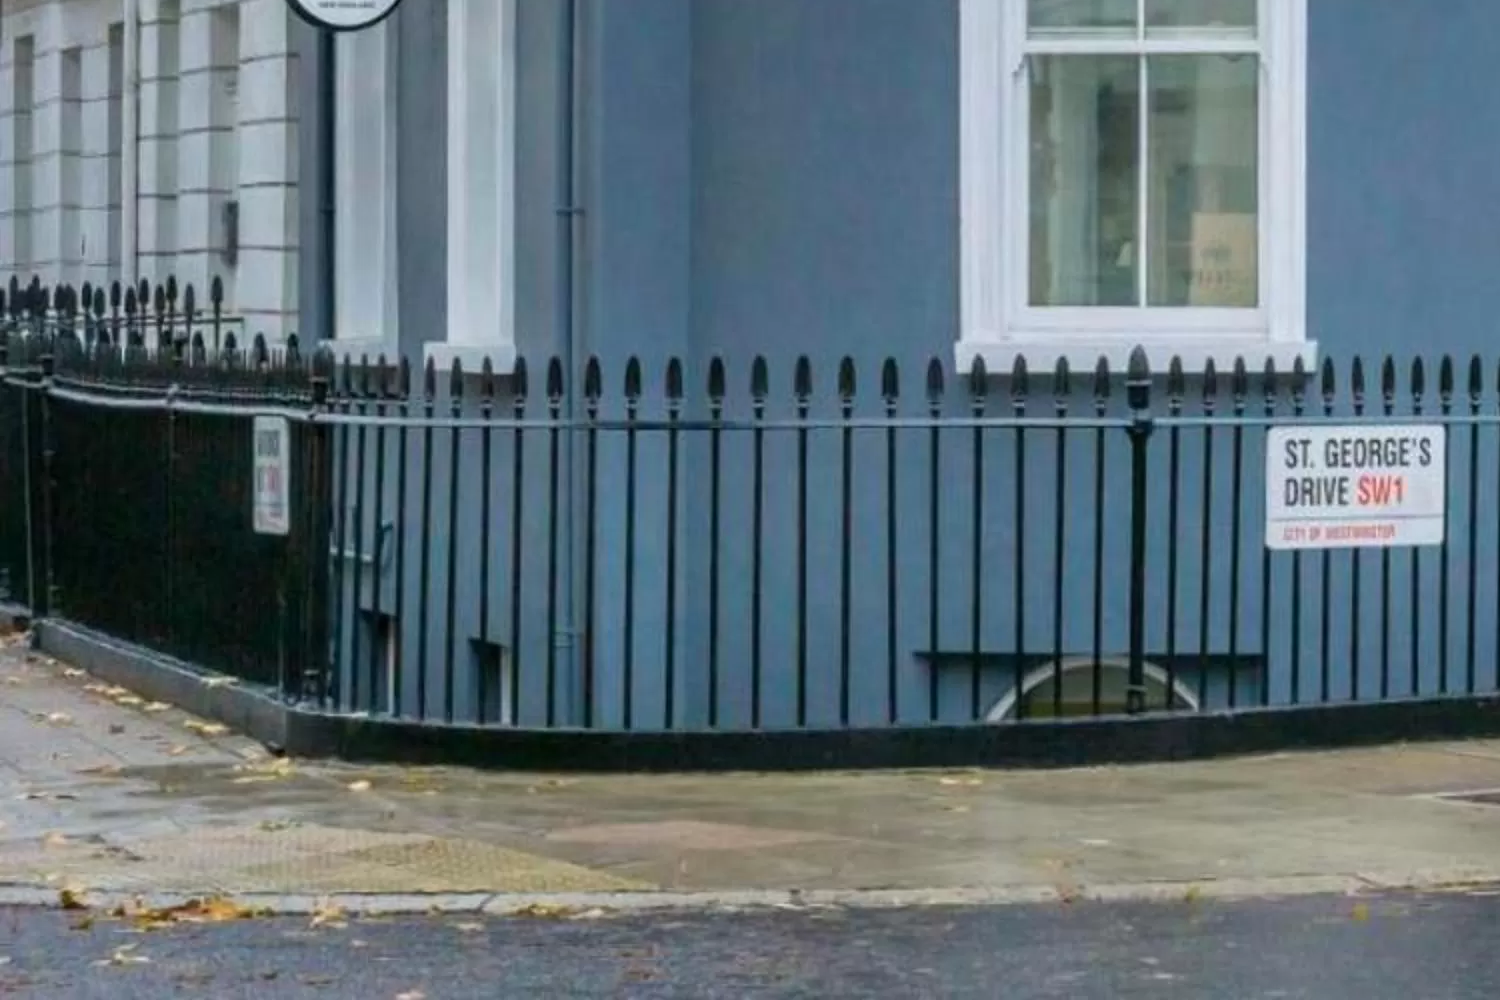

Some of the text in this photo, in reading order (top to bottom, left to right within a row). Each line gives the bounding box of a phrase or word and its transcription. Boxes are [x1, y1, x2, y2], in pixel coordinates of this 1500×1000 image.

[1284, 437, 1432, 469] ST. GEORGE'S
[1284, 474, 1404, 507] DRIVE SW1
